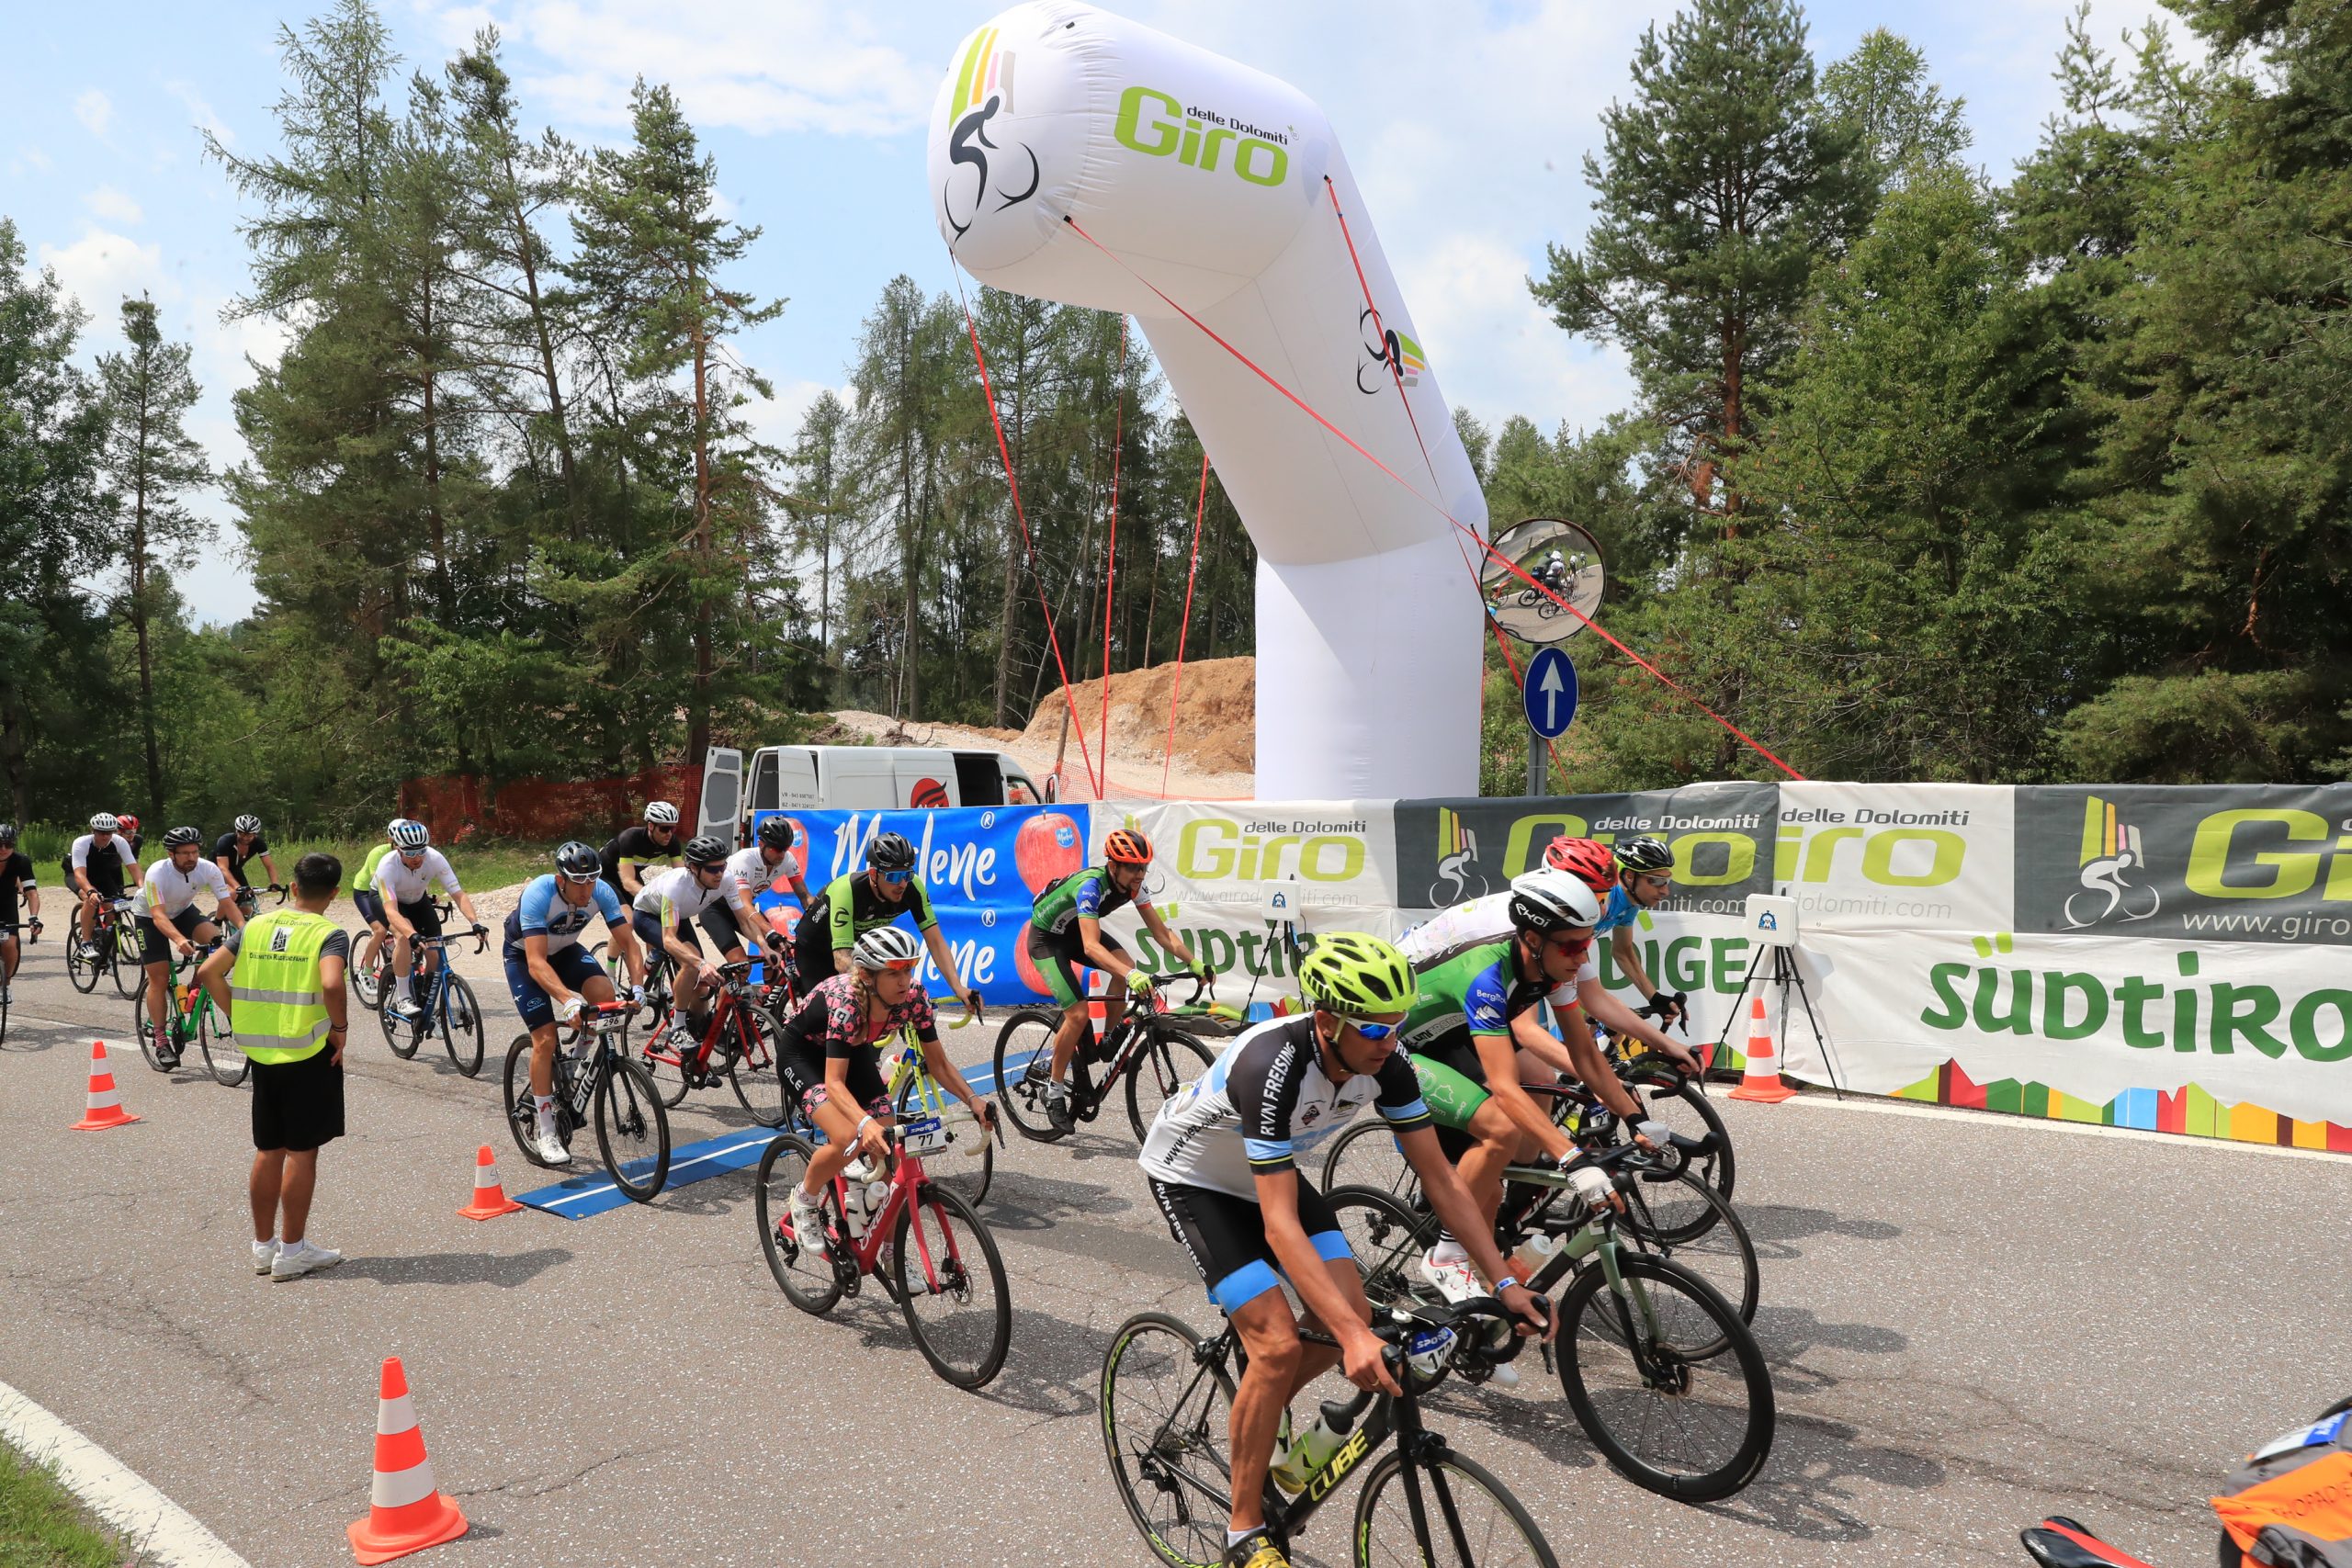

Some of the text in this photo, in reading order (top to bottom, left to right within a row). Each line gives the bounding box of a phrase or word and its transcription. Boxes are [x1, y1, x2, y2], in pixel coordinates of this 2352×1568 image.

[1114, 85, 1289, 187] Giro
[1187, 106, 1288, 145] delle Dolomiti
[1244, 820, 1366, 833] delle Dolomiti
[1594, 814, 1760, 830] delle Dolomiti
[1781, 807, 1970, 826] delle Dolomiti
[1176, 818, 1366, 882] Giro
[426, 970, 442, 1006] CANYON
[603, 1017, 619, 1027] 296
[572, 1066, 600, 1114] BMC
[1260, 1041, 1296, 1136] RVN FREISING
[1425, 1097, 1447, 1117] Team
[918, 1133, 934, 1147] 77
[1309, 1427, 1369, 1502] CUBE
